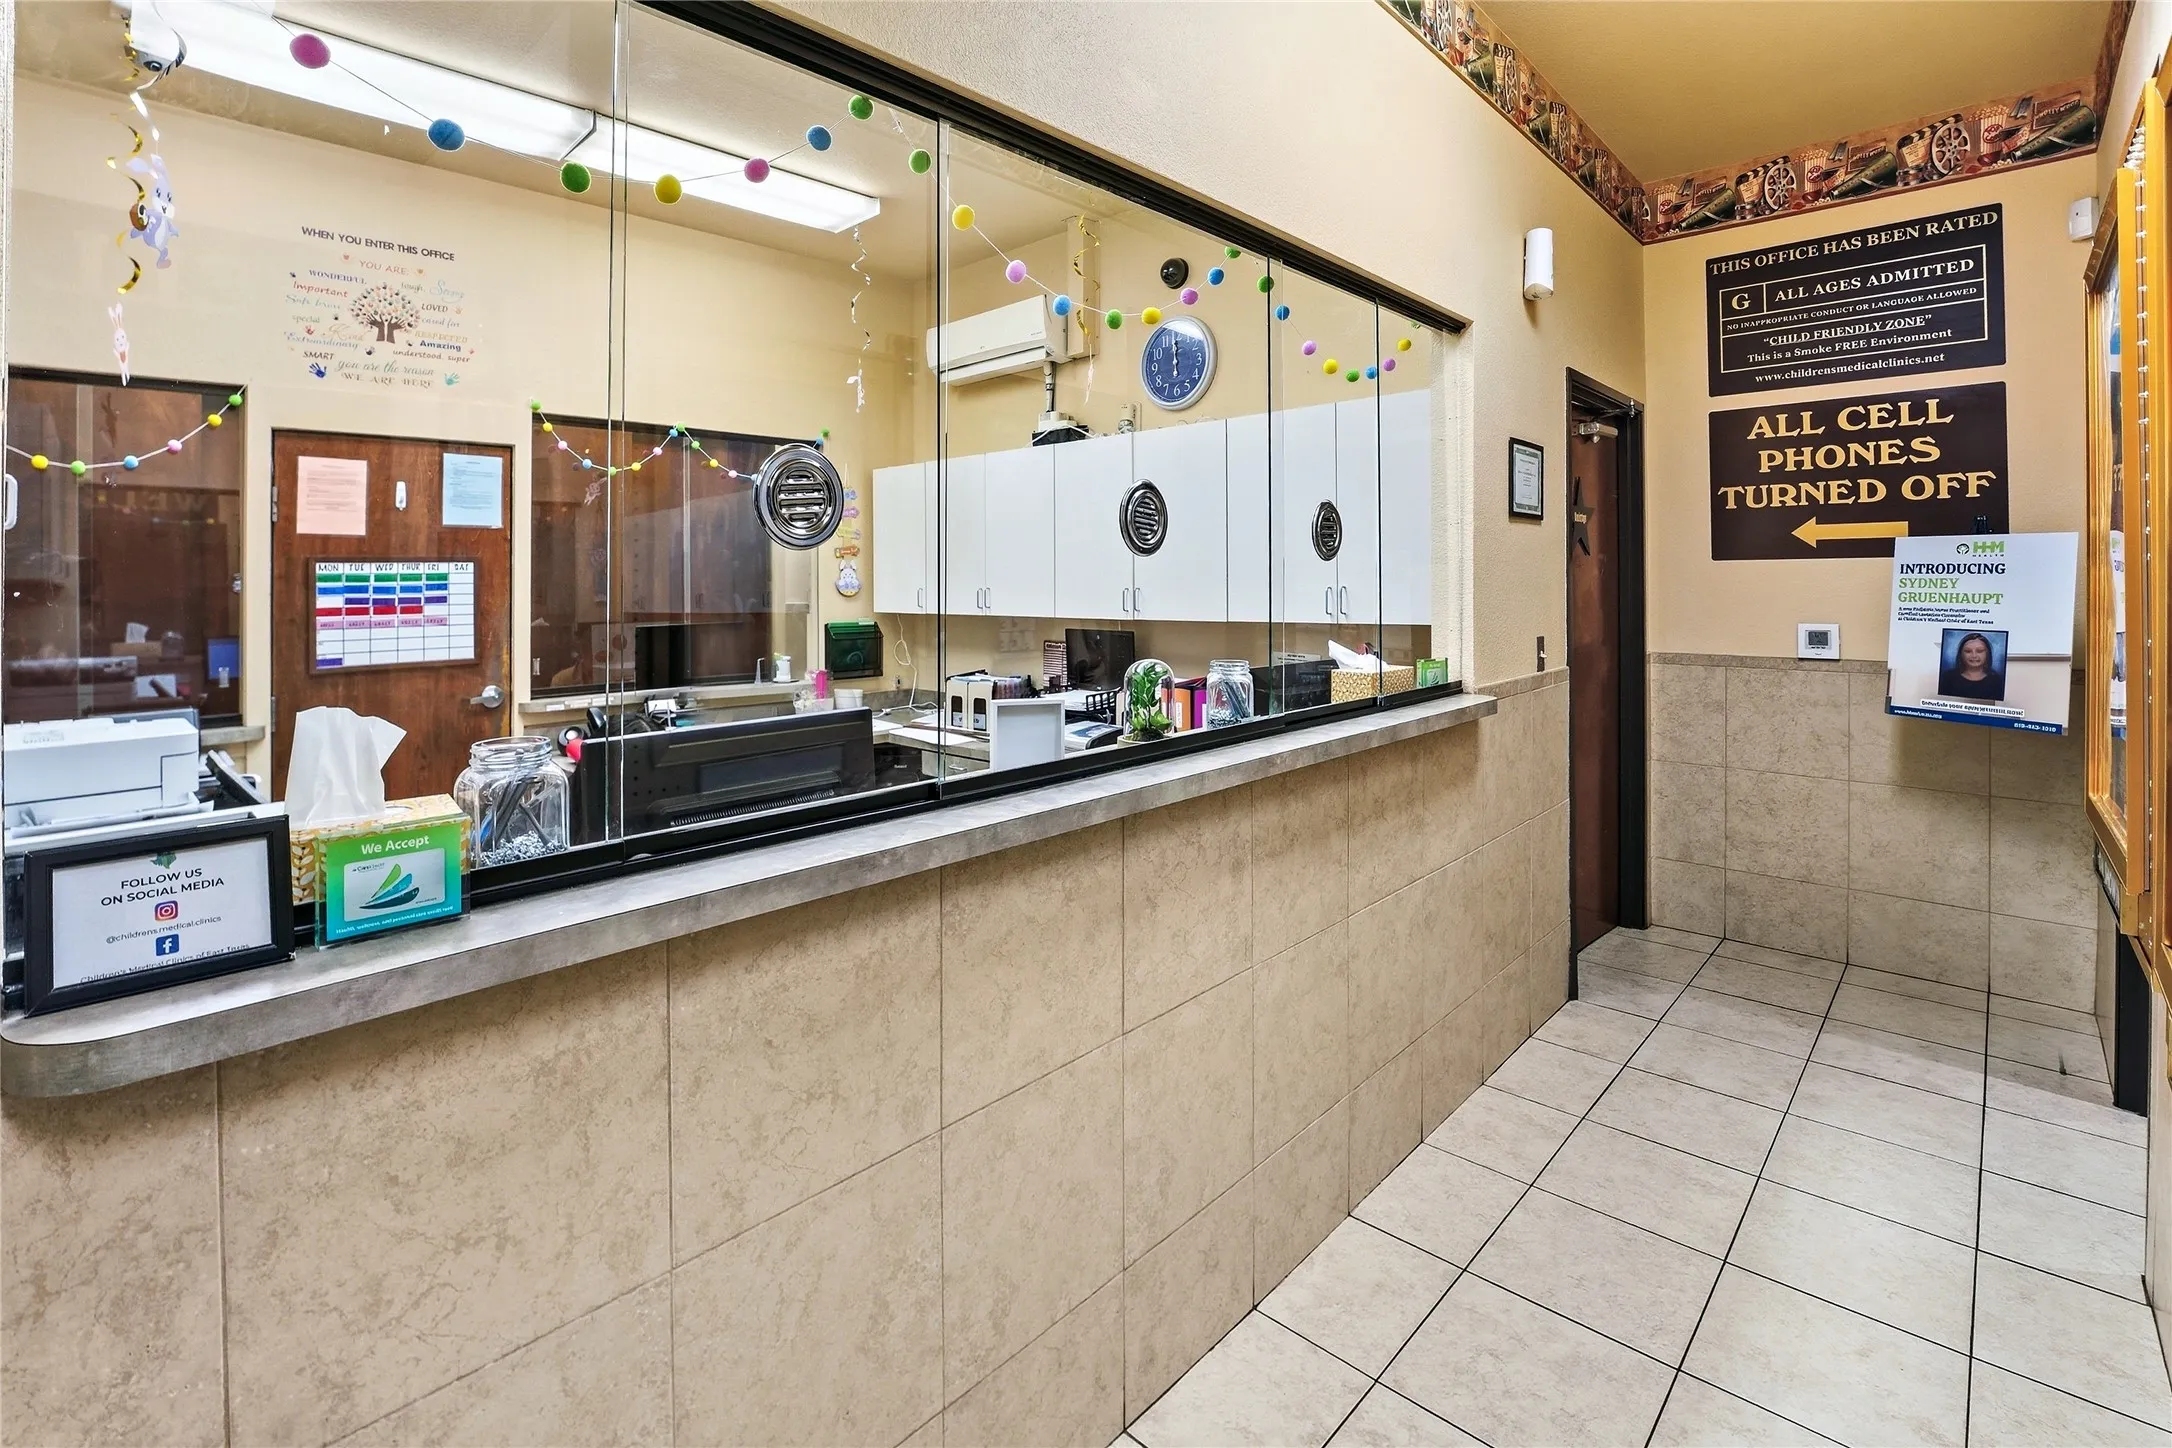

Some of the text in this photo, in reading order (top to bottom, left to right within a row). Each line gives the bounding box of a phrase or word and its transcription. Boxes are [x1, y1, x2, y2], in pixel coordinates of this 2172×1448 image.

[301, 226, 455, 262] WHEN YOU ENTER THIS OFFICE
[1710, 211, 1999, 276] THIS OFFICE HAS BEEN RATED
[359, 260, 382, 271] YOU
[1774, 258, 1975, 302] ALL AGES ADMITTED
[293, 280, 348, 298] Important
[421, 303, 448, 313] LOVED
[1731, 292, 1751, 310] G
[1726, 286, 1977, 331] NO INAPPROPRIATE CONDUCT OR LANGUAGE ALLOWED
[1813, 321, 1883, 341] FRIENDLY
[420, 340, 462, 352] Amazing
[1162, 335, 1169, 347] 11
[1192, 340, 1199, 351] 2
[1747, 328, 1953, 364] This is a Smoke FREE Environment
[302, 351, 334, 361] SMART
[447, 355, 471, 364] super
[1153, 347, 1163, 361] 10
[1196, 352, 1203, 366] 3
[335, 360, 360, 372] you
[363, 363, 381, 372] are
[403, 367, 434, 377] reason
[1151, 362, 1159, 376] 9
[1192, 367, 1200, 380] 4
[1754, 352, 1945, 383] www.childrensmedicalclinics.net
[1155, 374, 1162, 388] 8
[1184, 379, 1191, 392] 5
[1163, 383, 1169, 396] 7
[1173, 383, 1181, 397] 6
[1746, 398, 1955, 440] ALL CELL
[1758, 435, 1941, 473] PHONES
[1717, 470, 1997, 510] TURNED OFF
[318, 563, 469, 572] MON TUE WED THUR FRI SAT
[1899, 563, 2006, 575] INTRODUCING
[1898, 577, 1960, 590] SYDNEY
[1898, 591, 2004, 605] GRUENHAUPT
[361, 835, 430, 855] We Accept
[121, 868, 203, 889] FOLLOW US
[101, 877, 225, 907] ON SOCIAL MEDIA
